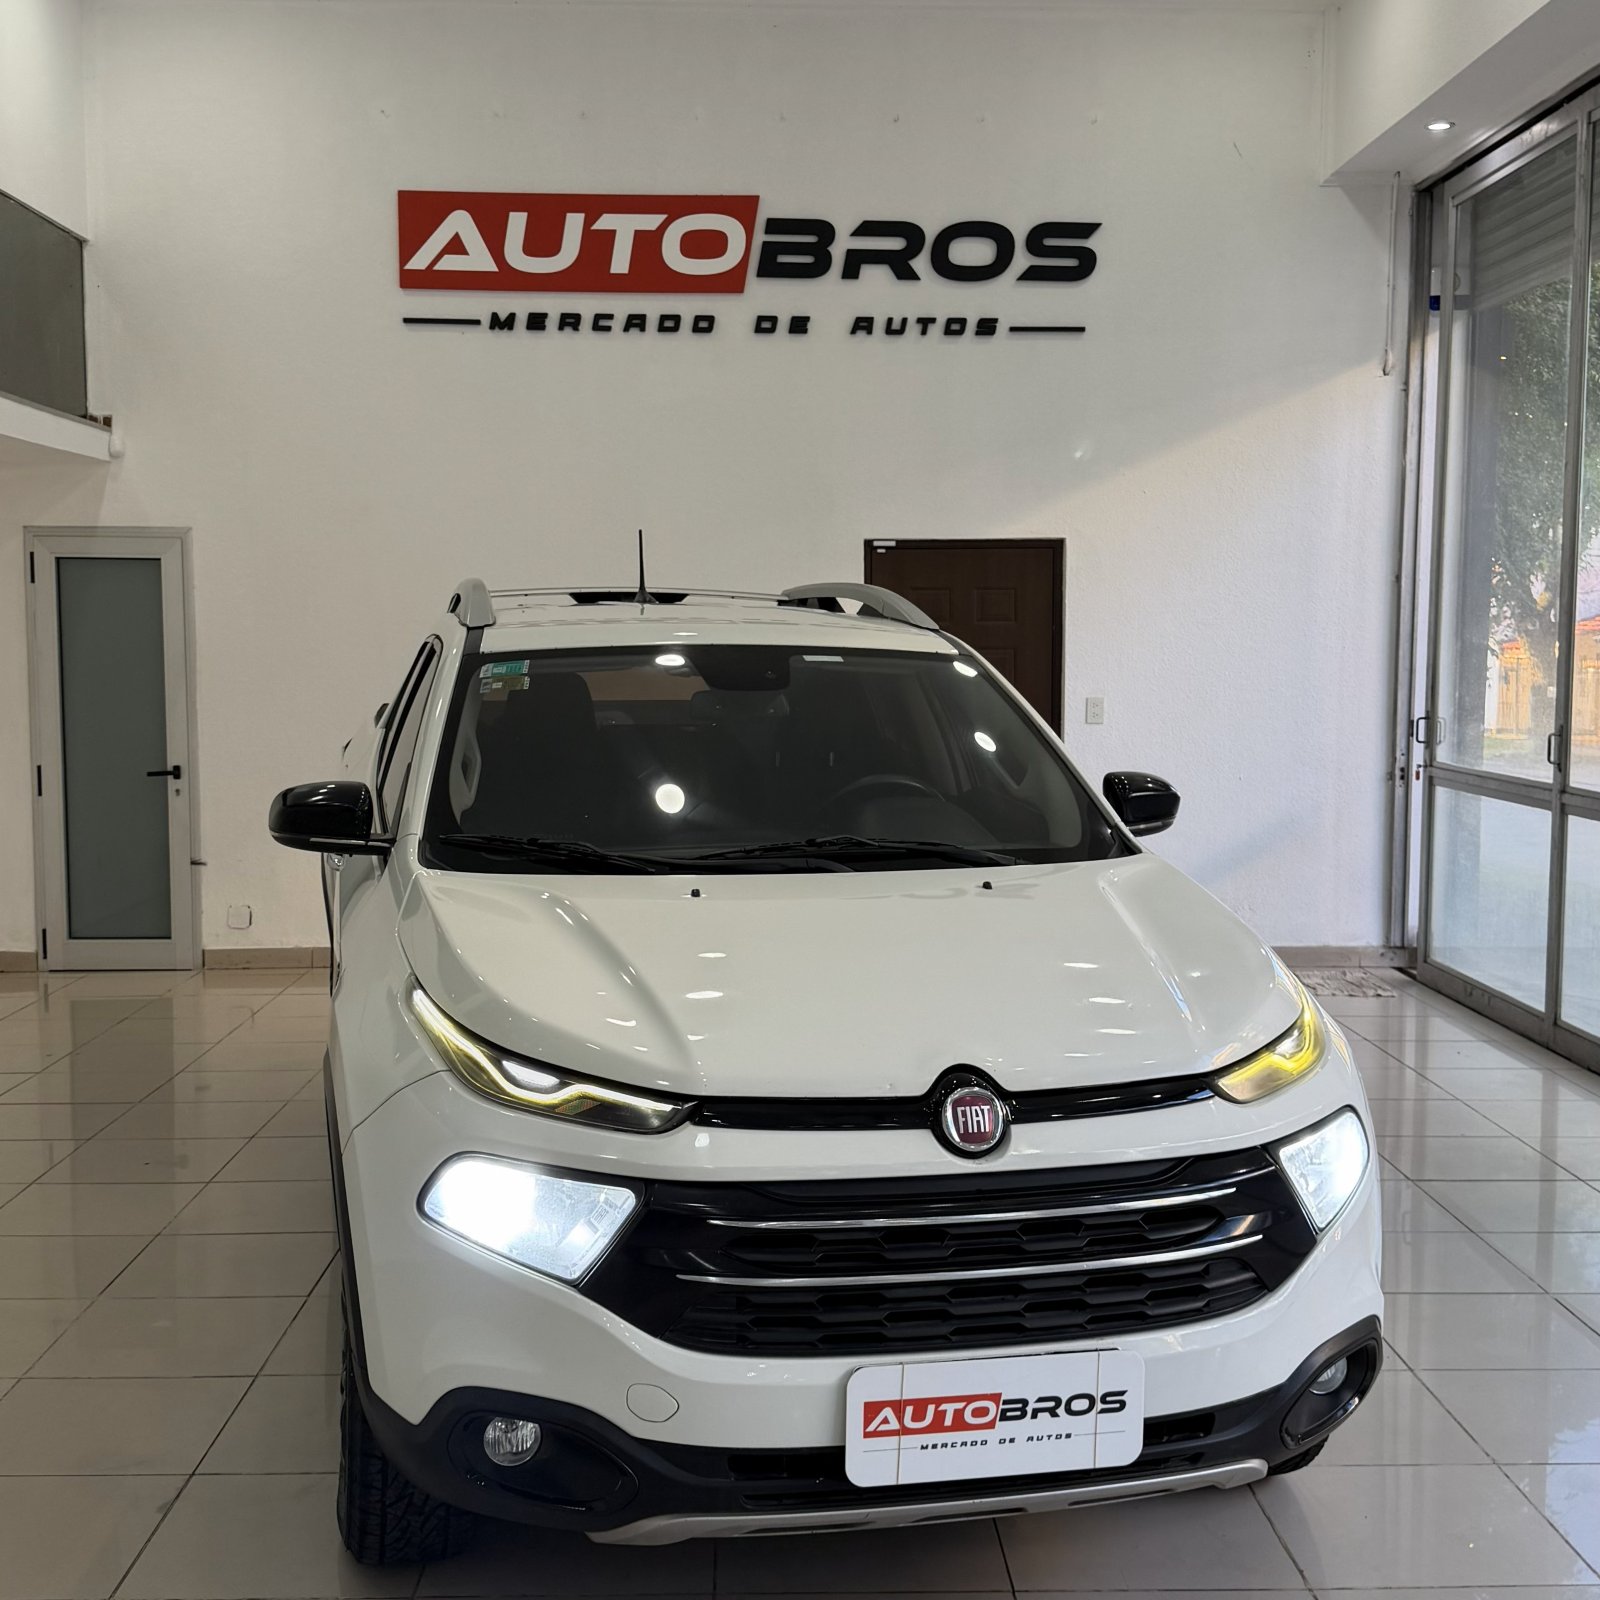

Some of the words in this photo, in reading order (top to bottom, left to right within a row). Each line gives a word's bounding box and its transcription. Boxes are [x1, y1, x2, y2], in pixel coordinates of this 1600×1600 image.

[403, 209, 1102, 282] AUTOBROS
[489, 312, 716, 335] MERCADO
[755, 316, 811, 336] DE
[850, 316, 999, 337] AUTOS
[957, 1105, 990, 1133] FIAT
[865, 1390, 1128, 1432] AUTOBROS
[920, 1440, 988, 1450] MERCADO
[998, 1437, 1016, 1445] DE
[1026, 1433, 1073, 1442] AUTOS
